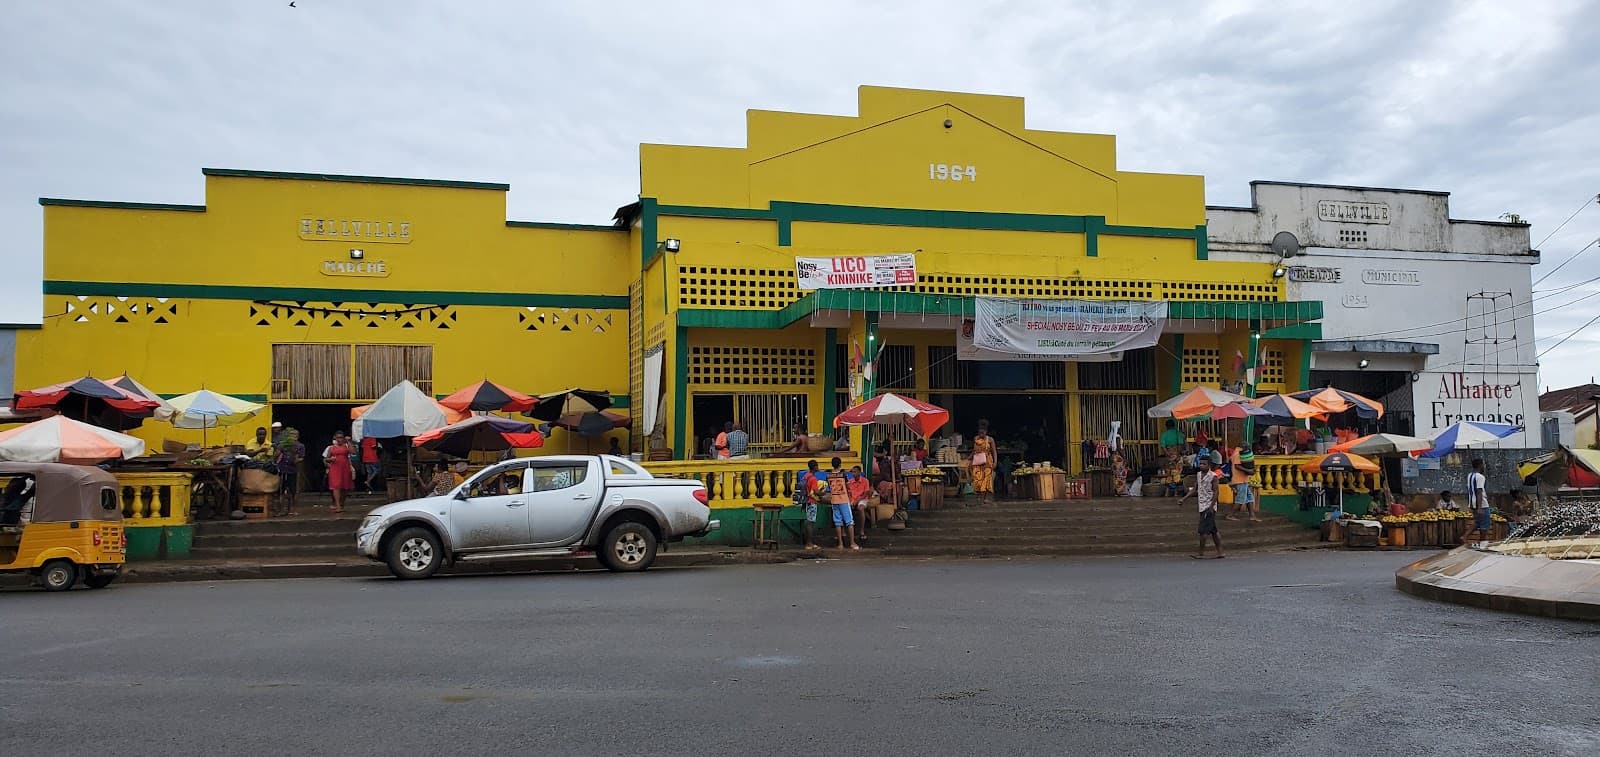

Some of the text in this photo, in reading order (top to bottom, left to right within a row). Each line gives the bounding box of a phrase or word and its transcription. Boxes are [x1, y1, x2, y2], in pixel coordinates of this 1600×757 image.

[929, 163, 977, 182] 1964
[1319, 203, 1388, 220] HELLVILLE
[301, 218, 410, 239] HELLVILLE
[324, 260, 386, 273] MARCHÉ
[797, 261, 818, 272] Nosy
[831, 256, 866, 273] LICO
[798, 270, 810, 279] Be
[827, 273, 873, 285] KININIKE
[1367, 271, 1421, 284] MUNICIPAL
[1067, 322, 1075, 331] BE
[1438, 372, 1513, 399] Alliance
